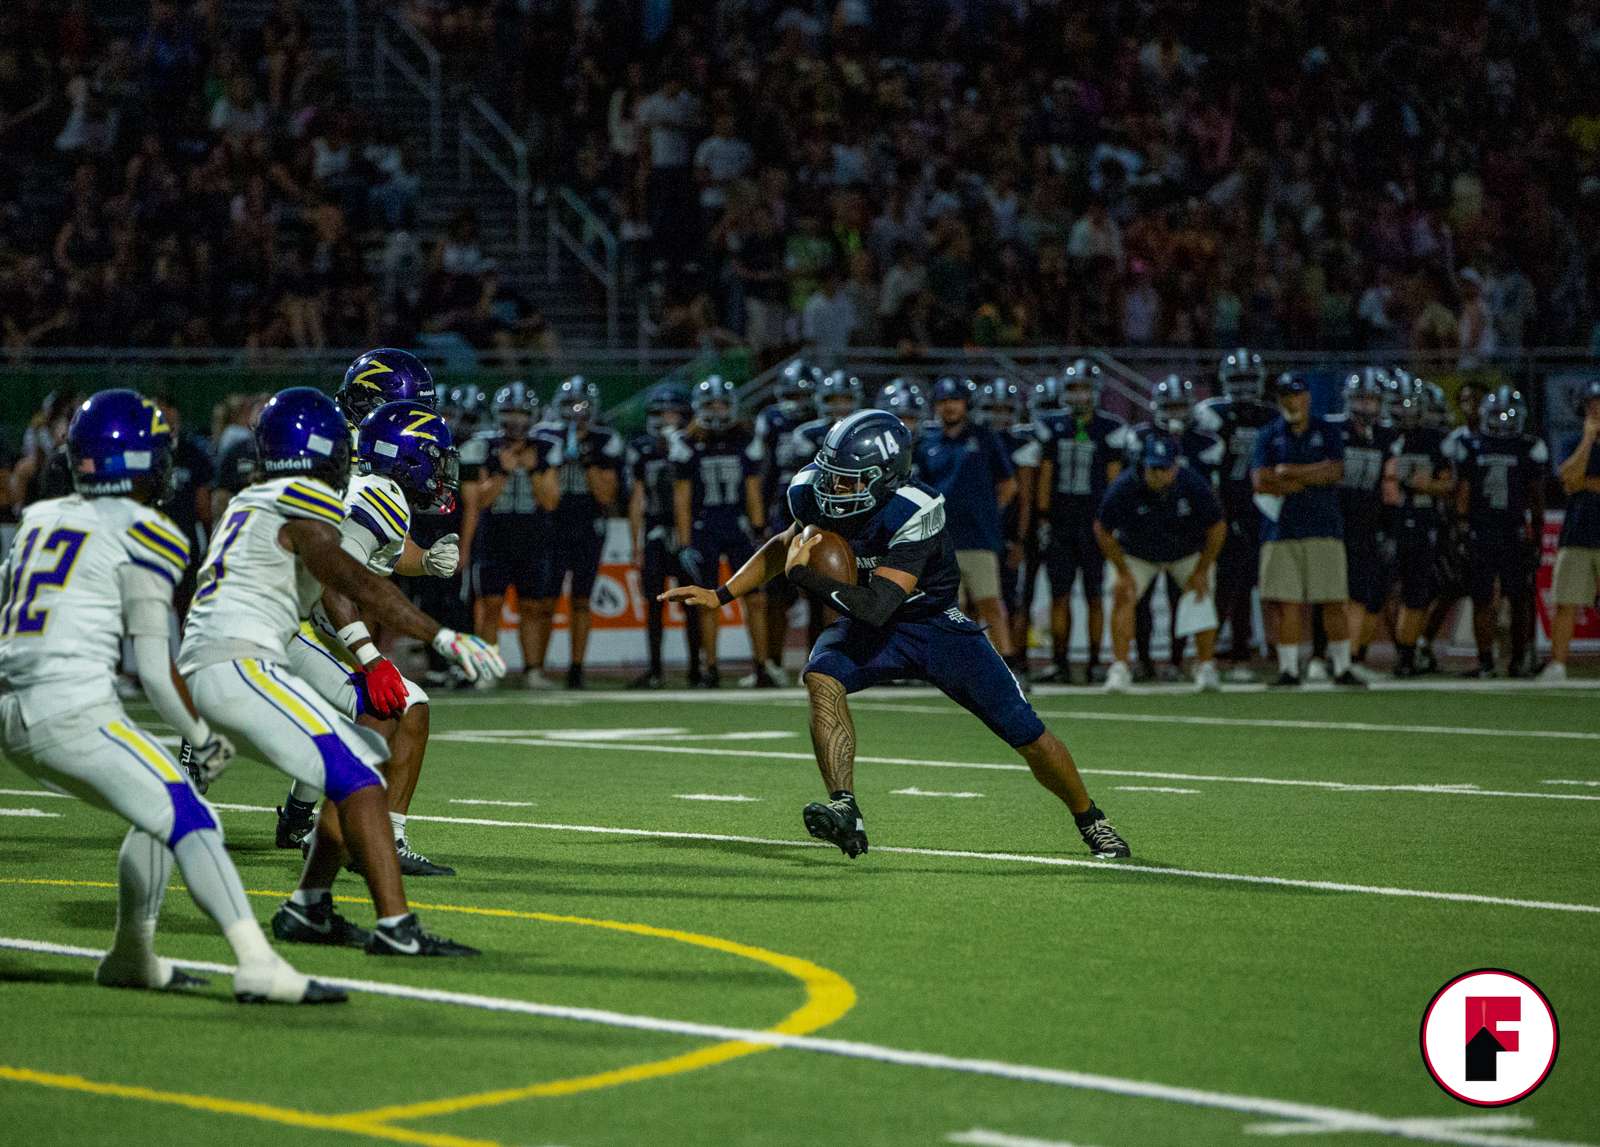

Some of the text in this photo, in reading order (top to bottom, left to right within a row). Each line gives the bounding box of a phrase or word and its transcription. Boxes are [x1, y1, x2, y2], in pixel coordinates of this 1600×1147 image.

[352, 360, 395, 391] Z
[399, 409, 439, 442] Z
[874, 430, 900, 460] 14
[264, 457, 312, 471] Riddell
[1, 526, 92, 637] 12
